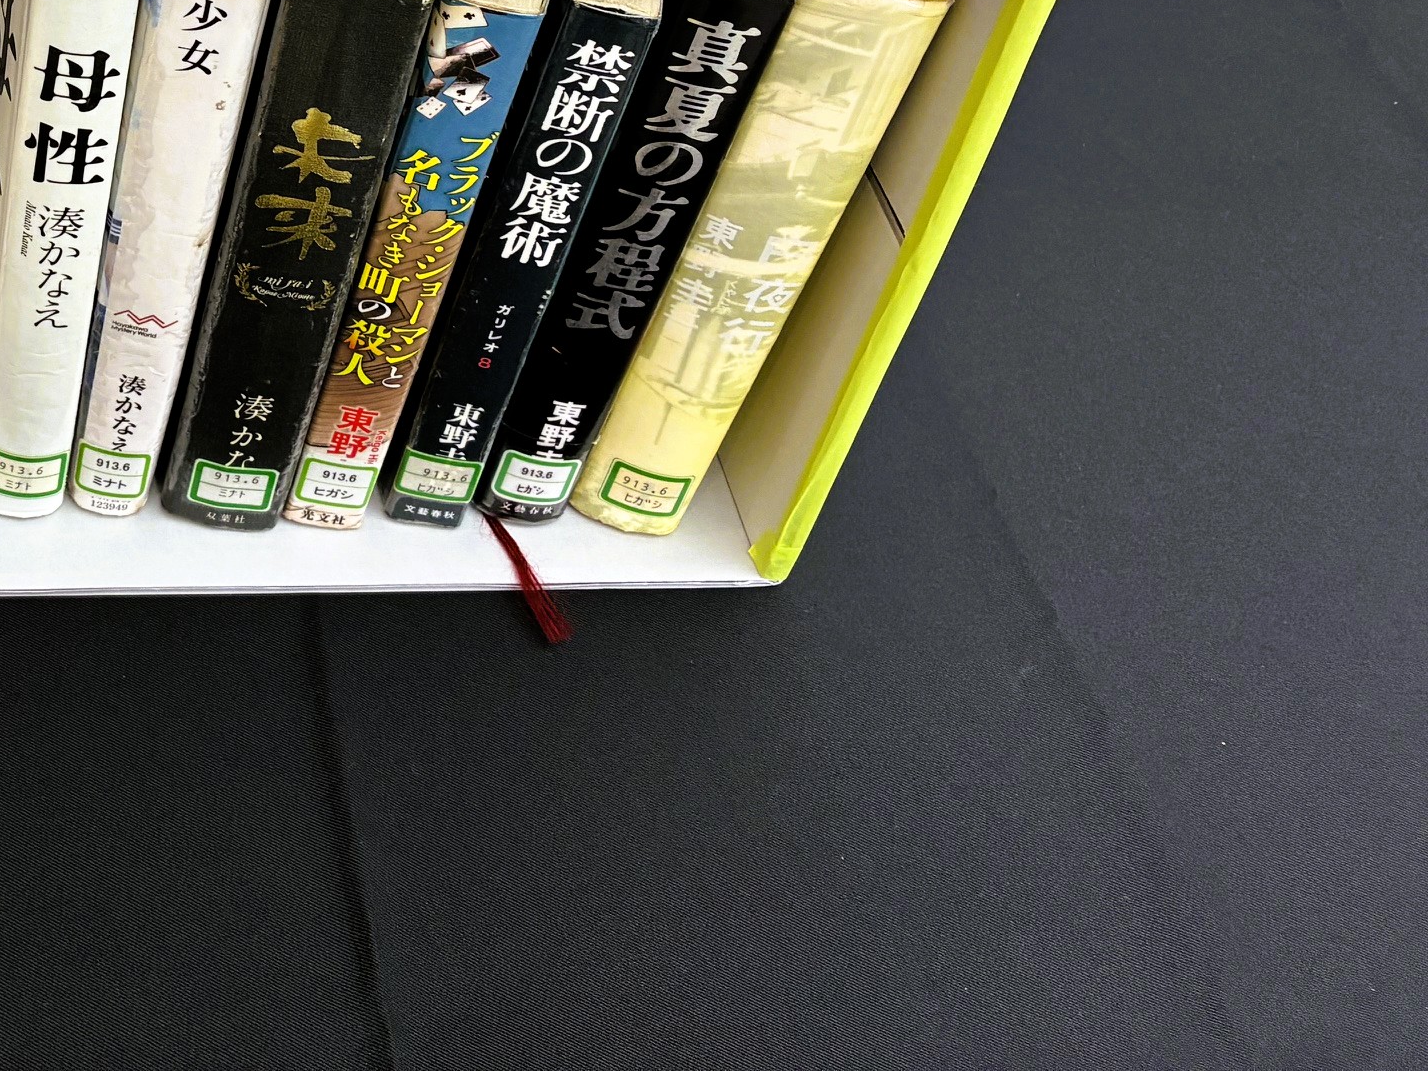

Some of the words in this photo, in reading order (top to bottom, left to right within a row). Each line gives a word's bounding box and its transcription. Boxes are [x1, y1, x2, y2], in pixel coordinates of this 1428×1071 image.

[24, 44, 122, 187] 母性
[499, 40, 636, 269] 禁断の魔術
[255, 106, 376, 260] 未来
[565, 16, 762, 340] 真夏の方程式
[381, 130, 498, 389] ブラック・ショーマンと
[34, 206, 85, 329] 湊かなえ
[337, 149, 442, 386] 名もなき町の殺人
[137, 331, 157, 339] World
[0, 461, 44, 476] 913.6
[96, 457, 131, 472] 913.6
[214, 471, 260, 485] 913.6
[322, 470, 357, 483] 913.6
[422, 468, 468, 483] 913.6
[520, 467, 554, 480] 913.6
[5, 479, 32, 491] ミナト
[92, 475, 128, 489] ミナト
[516, 483, 545, 496] ヒガシ
[622, 475, 668, 496] 913.6
[218, 488, 246, 499] ミナト
[313, 486, 354, 500] ヒガシ
[624, 491, 663, 509] ヒガシ
[90, 499, 129, 511] 123949
[404, 504, 456, 520] 文藝春秋
[300, 507, 346, 526] 光文社
